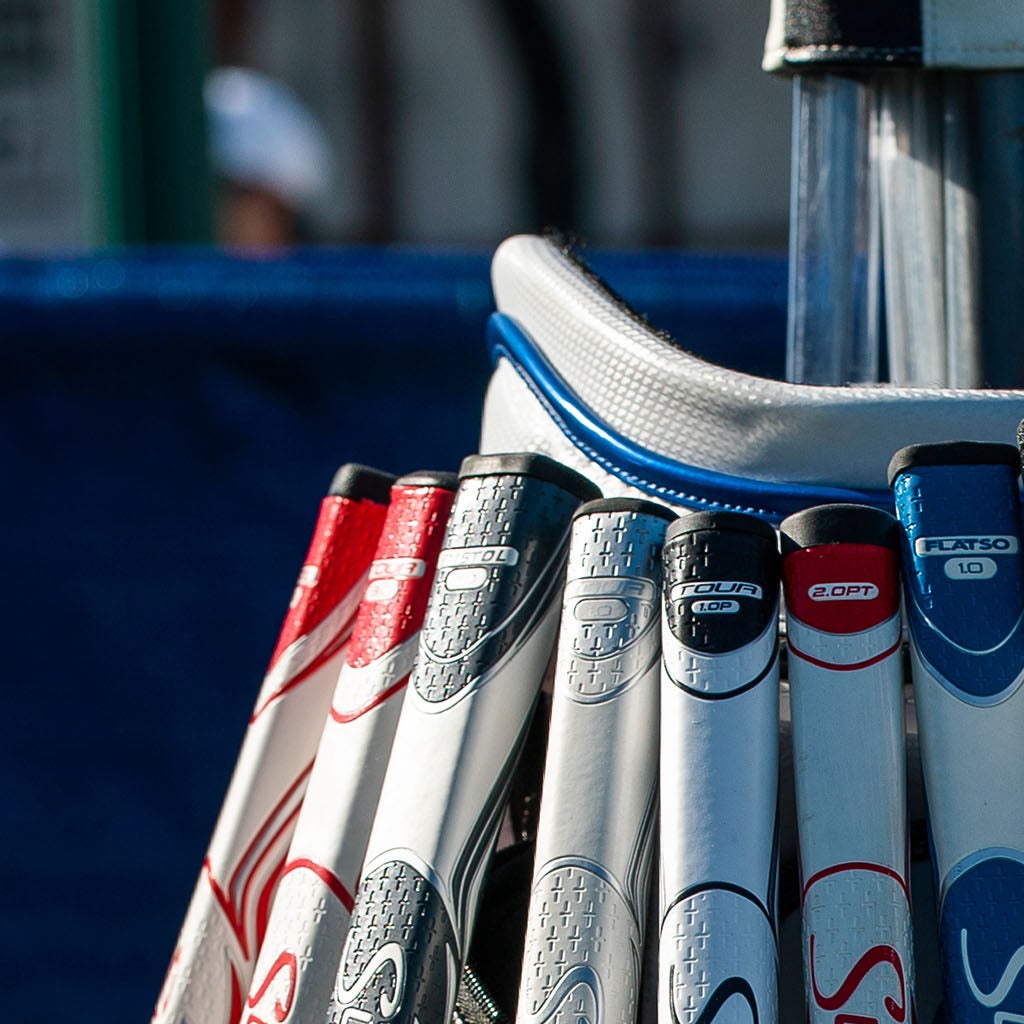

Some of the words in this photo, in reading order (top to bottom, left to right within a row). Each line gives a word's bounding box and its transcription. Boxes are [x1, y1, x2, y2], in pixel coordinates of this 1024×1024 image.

[924, 538, 1010, 552] FLATSO
[958, 562, 984, 574] 1.0
[681, 583, 758, 596] TOUR
[812, 585, 874, 598] 2.0PT
[700, 602, 732, 612] 1.0P
